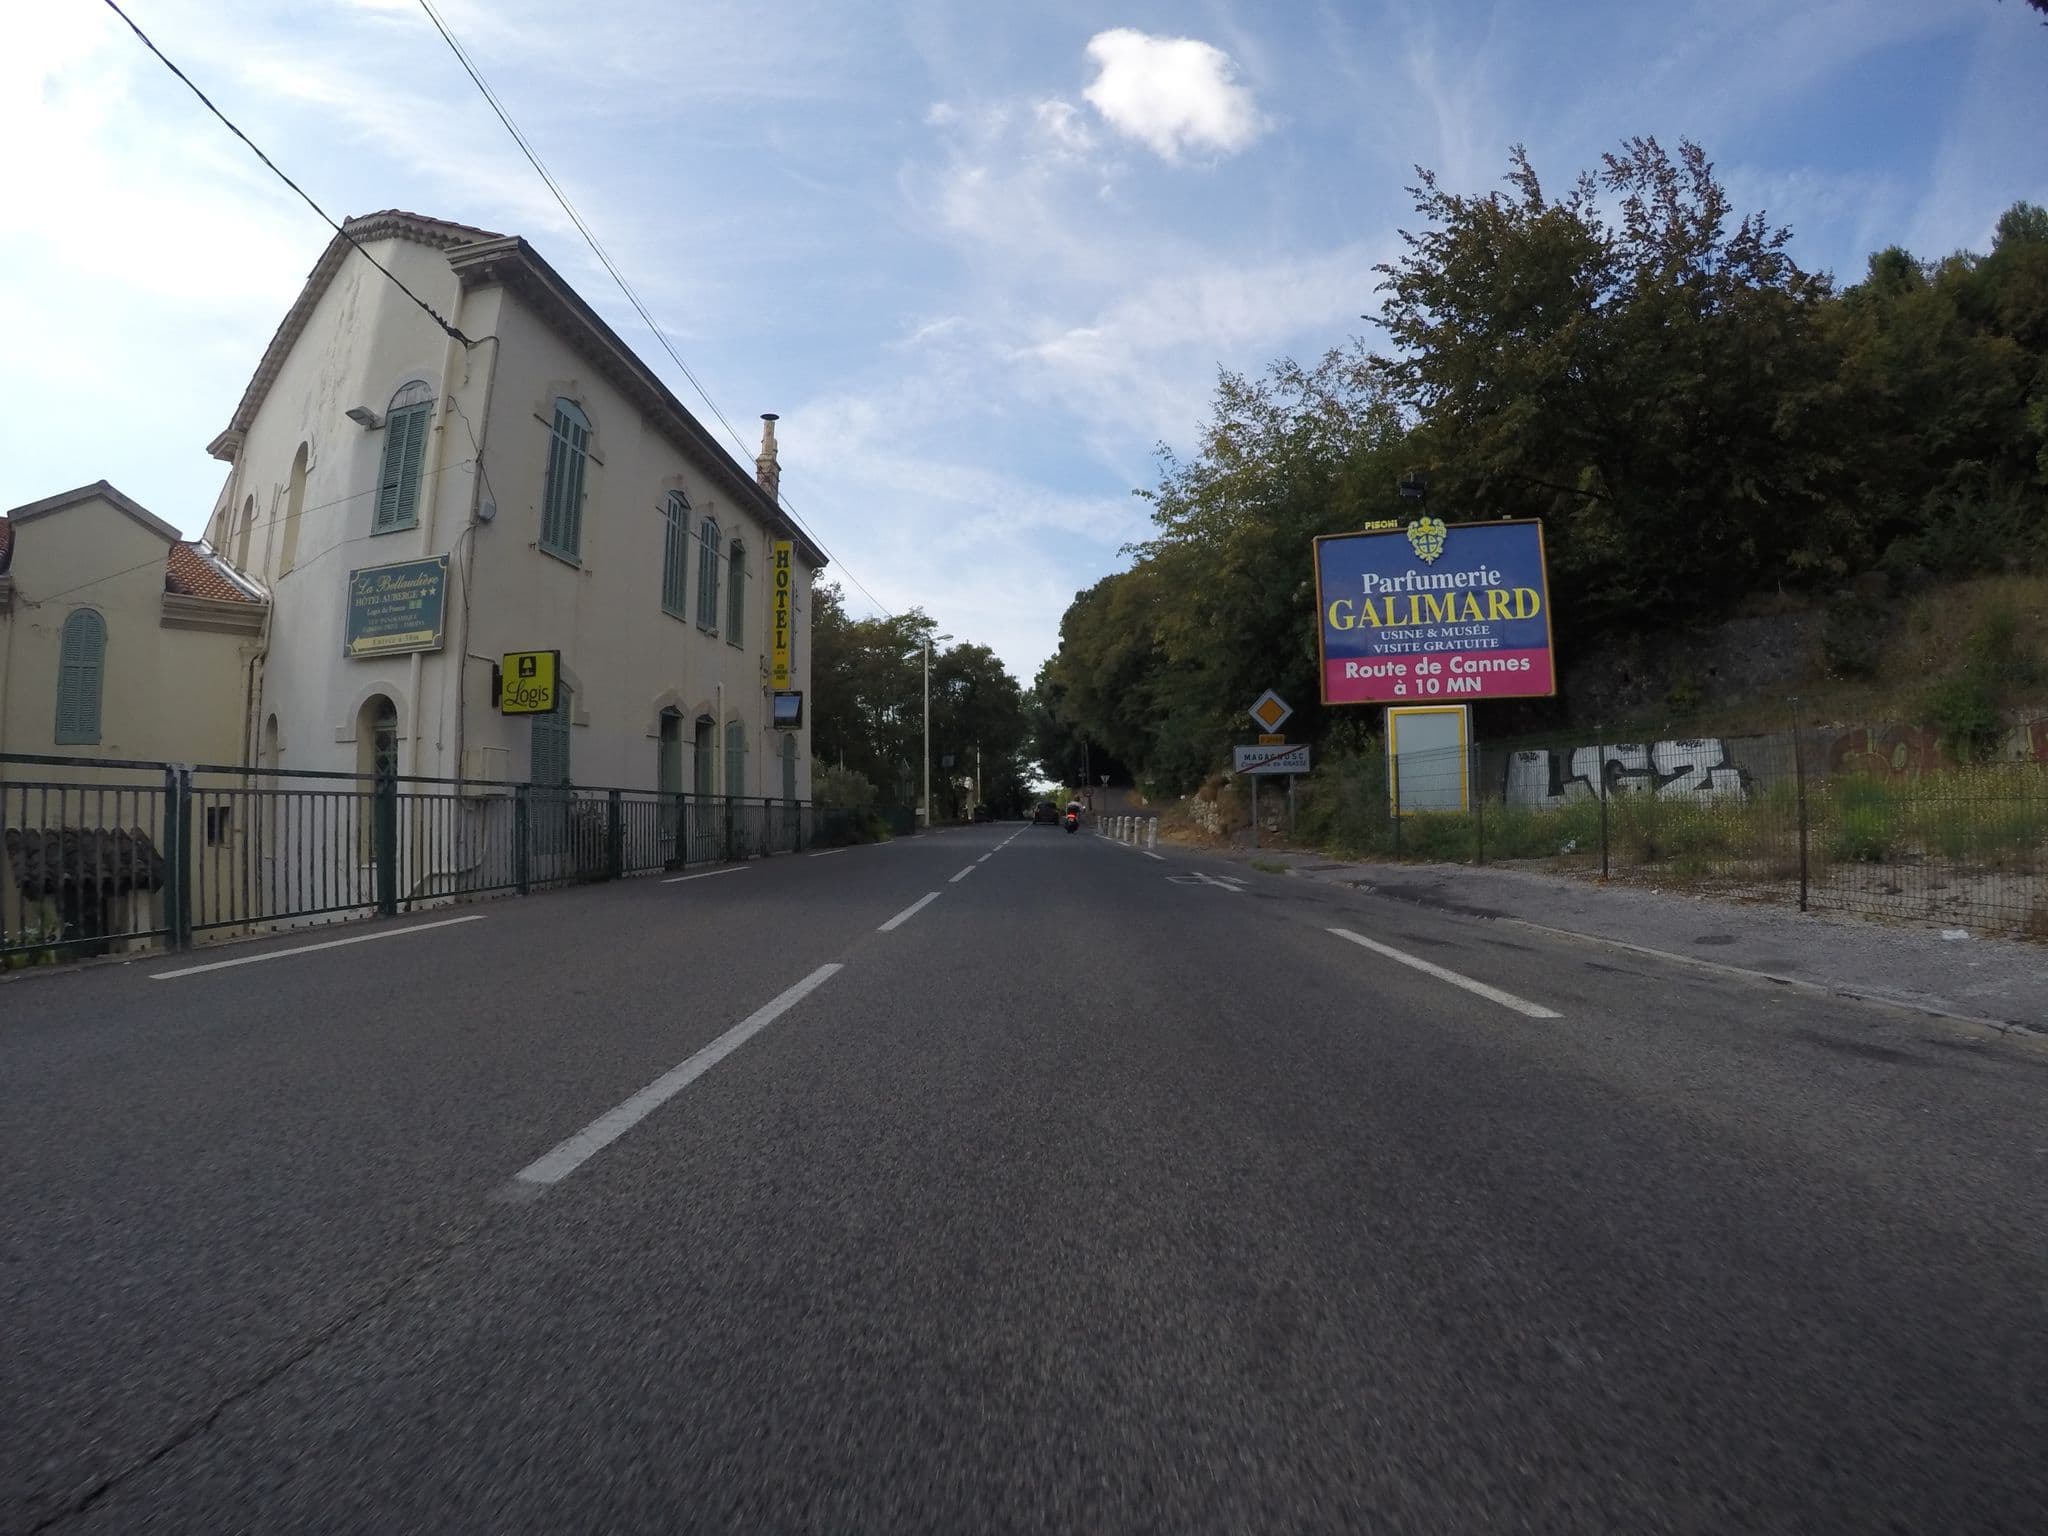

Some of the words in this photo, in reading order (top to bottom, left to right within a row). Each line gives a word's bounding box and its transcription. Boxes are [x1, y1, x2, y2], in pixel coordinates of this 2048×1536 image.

[1362, 564, 1502, 594] Parfumerie
[382, 591, 418, 602] AUBERGE
[775, 550, 790, 650] HOTEL
[1328, 587, 1541, 631] GALIMARD
[1380, 628, 1424, 641] USINE
[1426, 628, 1438, 638] &
[1440, 622, 1490, 636] MUSÉE
[1372, 640, 1421, 654] VISITE
[1423, 637, 1500, 651] GRATUITE
[1345, 661, 1408, 679] Route
[1415, 656, 1442, 675] de
[1449, 656, 1531, 672] Cannes
[504, 679, 550, 708] Logis
[1393, 679, 1407, 695] à
[1416, 678, 1441, 694] 10
[1446, 676, 1482, 693] MN
